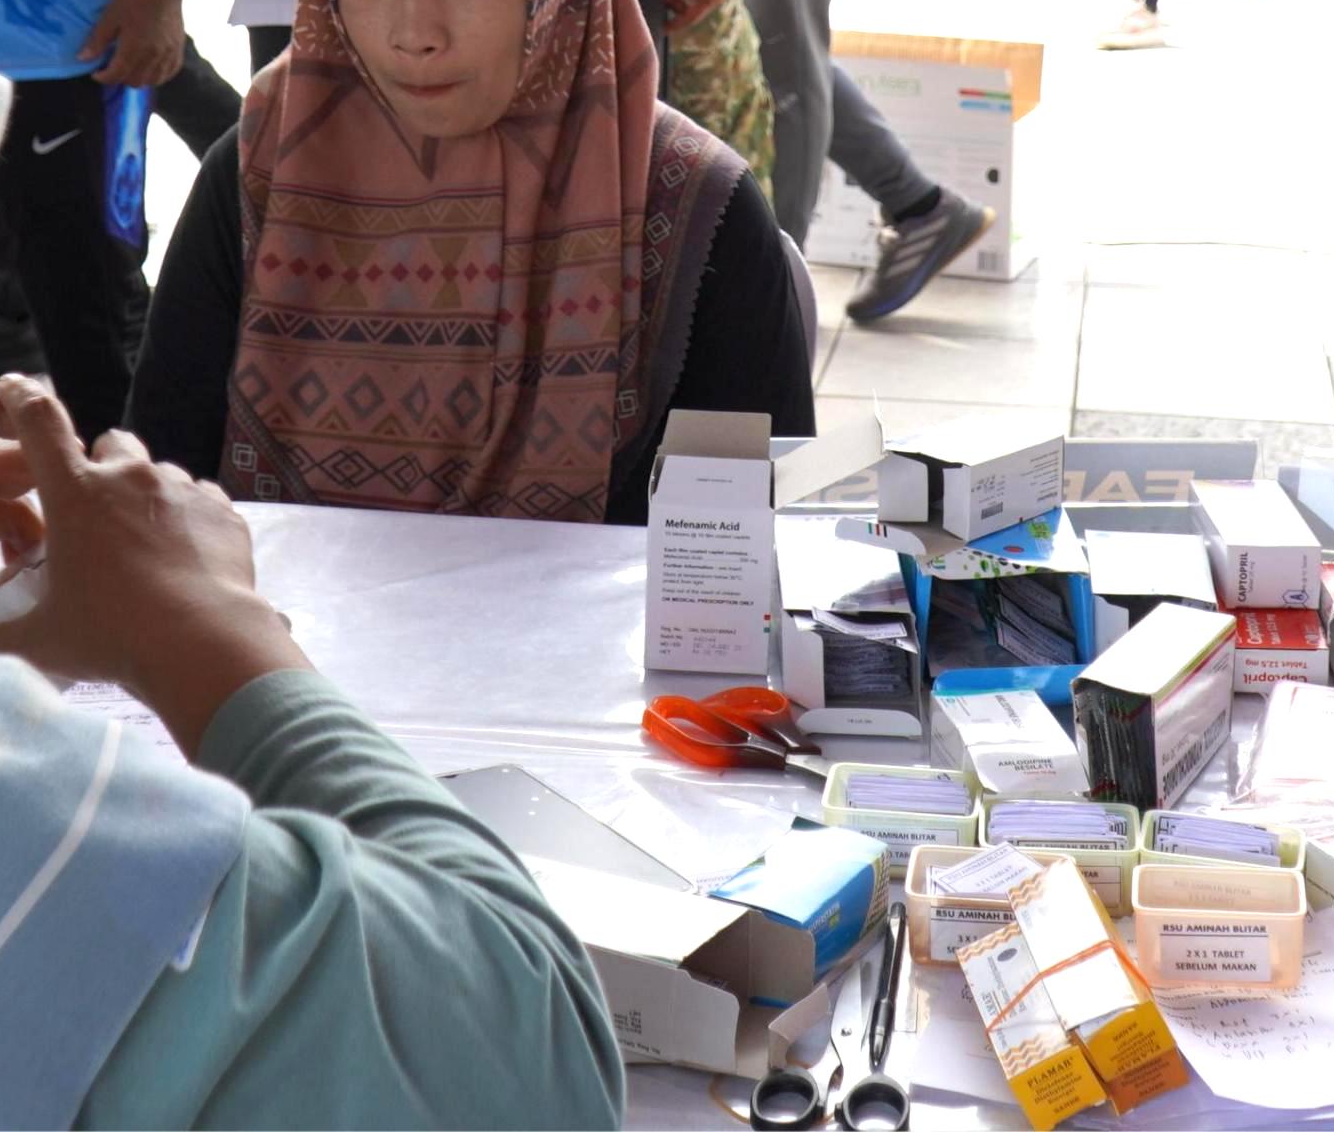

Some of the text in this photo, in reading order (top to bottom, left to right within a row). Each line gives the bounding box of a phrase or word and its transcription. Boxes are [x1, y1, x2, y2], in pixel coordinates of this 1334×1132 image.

[665, 519, 740, 532] Mefenamic Acid
[1237, 551, 1249, 604] CAPTOPRIL
[998, 758, 1053, 767] AMLODIPINE
[877, 831, 908, 841] AMINAH
[909, 832, 937, 842] BLITAR
[935, 909, 955, 919] RSU
[957, 910, 1001, 921] AMINAH
[1162, 924, 1267, 934] RSU AMINAH BLITAR
[1186, 950, 1245, 959] 2 X 1 TABLET
[1175, 961, 1257, 972] SEBELUM MAKAN
